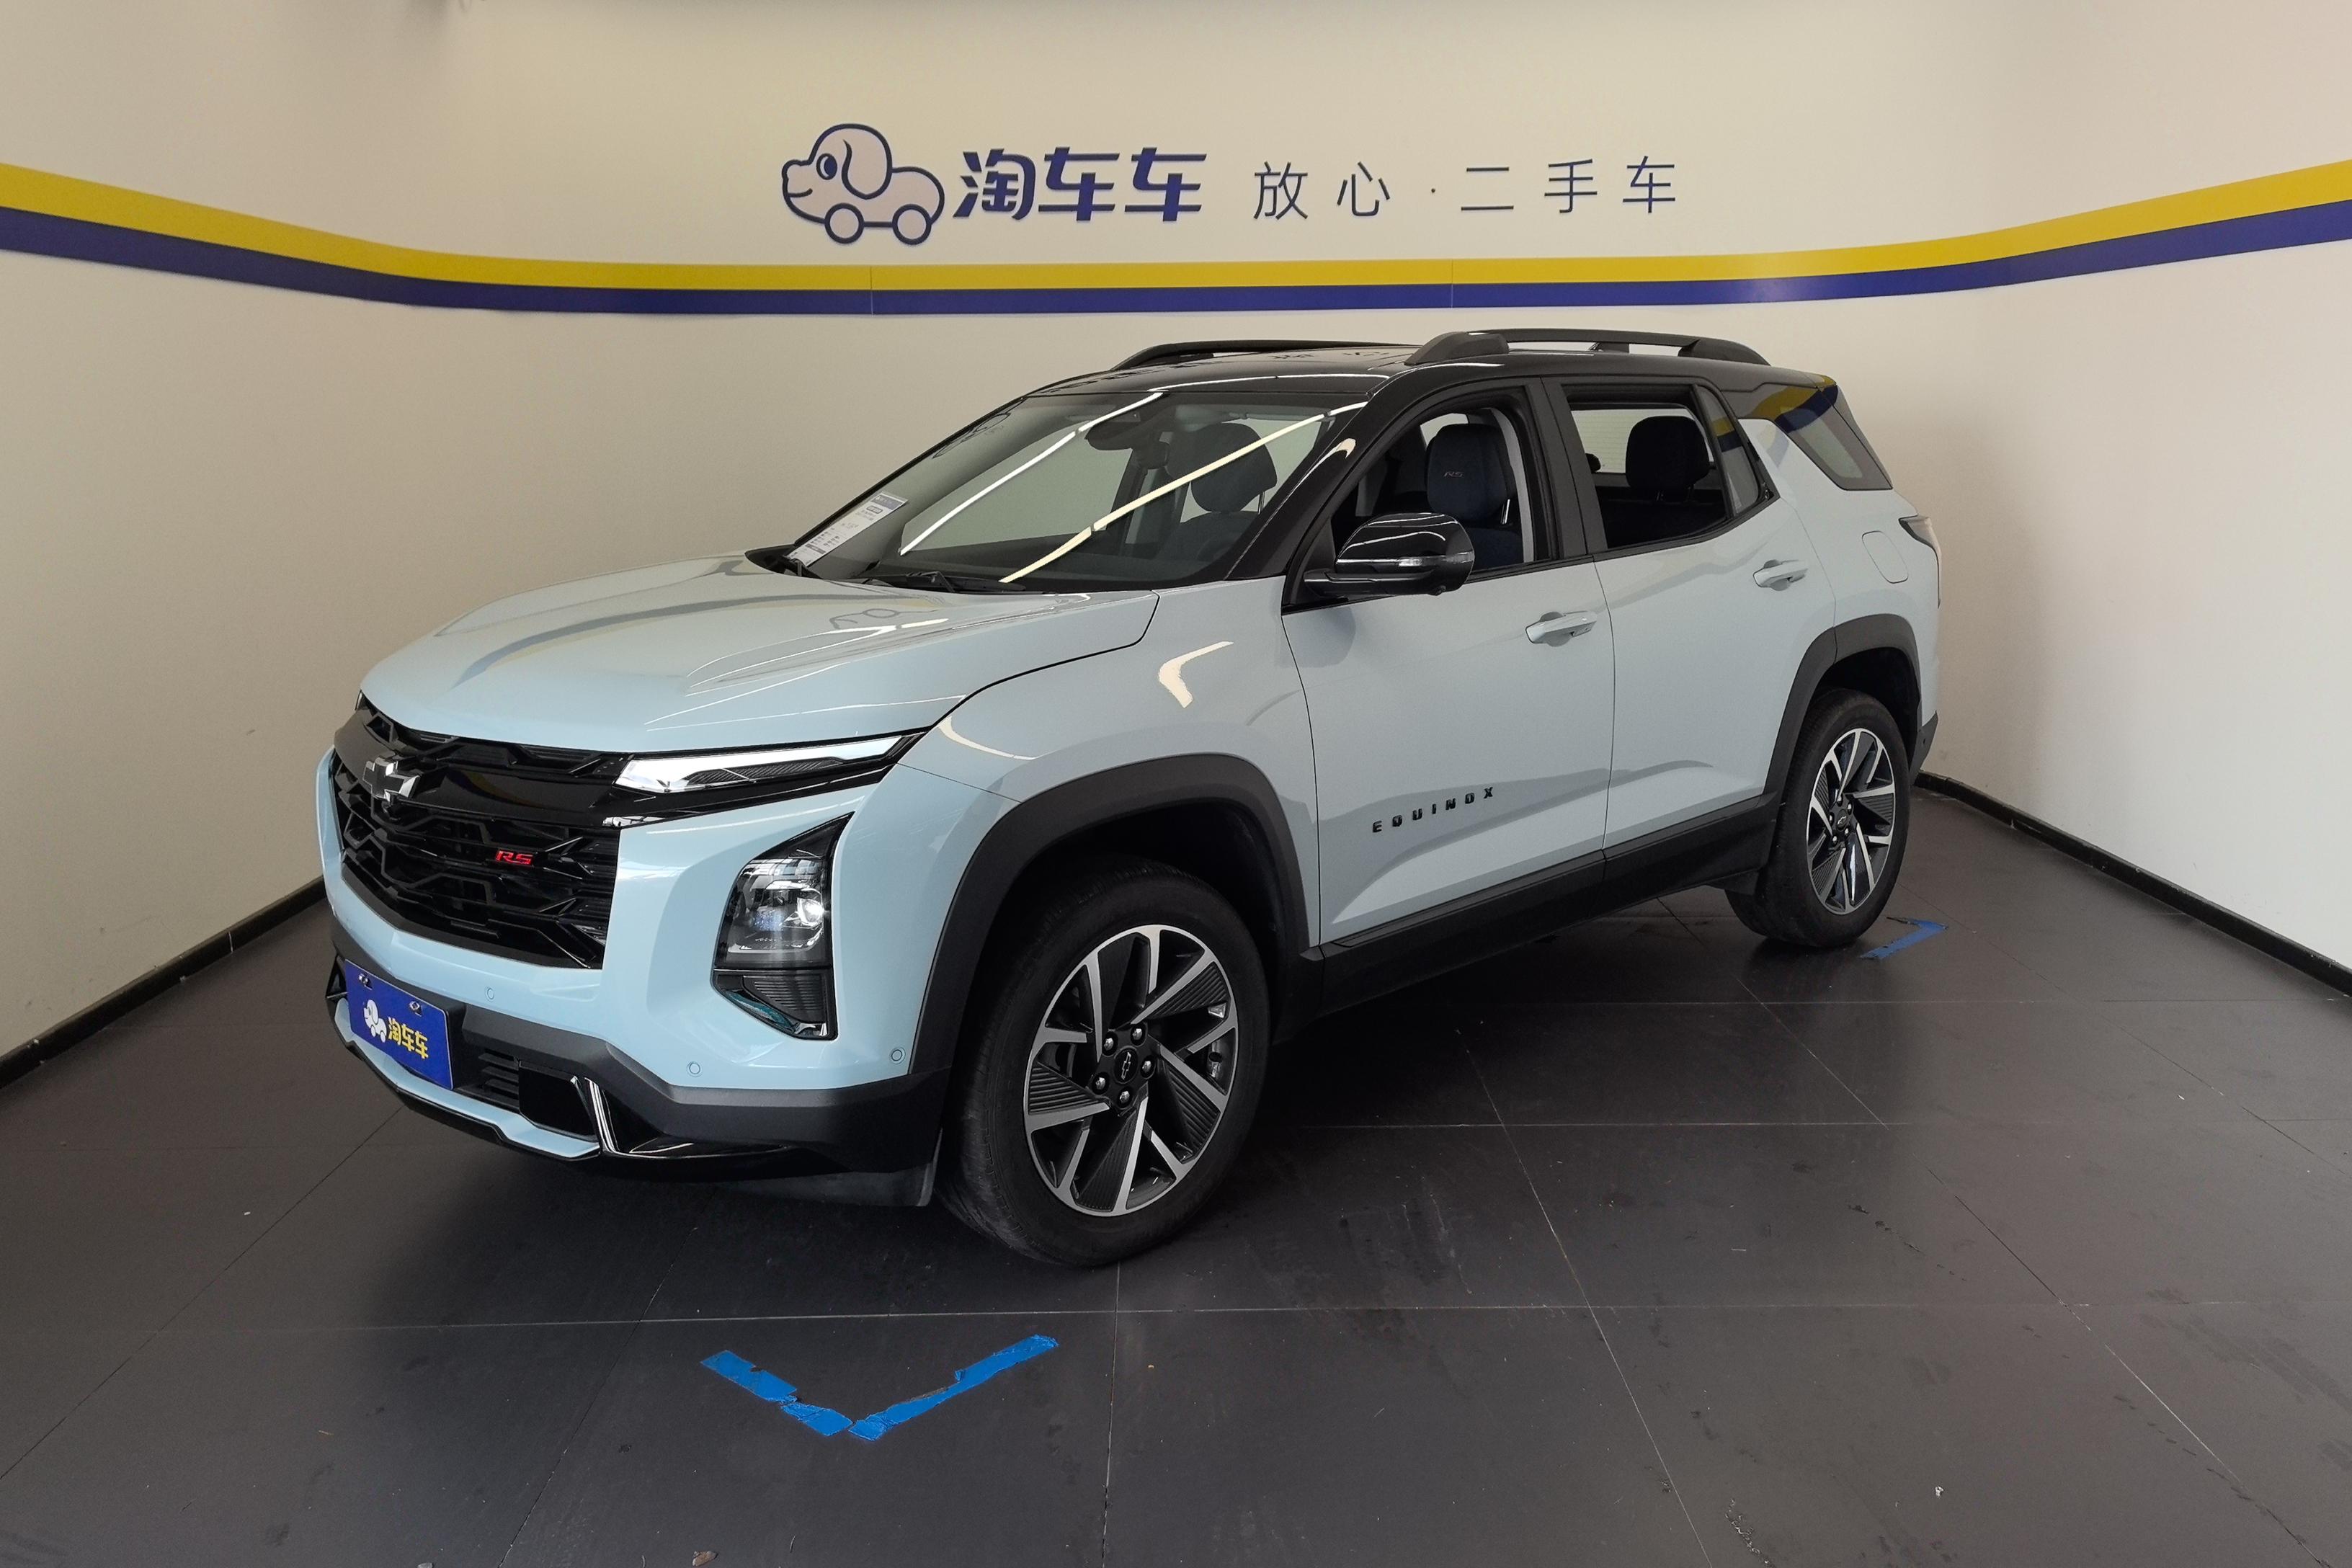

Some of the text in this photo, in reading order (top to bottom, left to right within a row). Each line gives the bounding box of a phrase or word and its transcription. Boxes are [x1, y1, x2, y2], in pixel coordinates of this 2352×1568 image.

[952, 146, 1207, 222] 淘车车
[1372, 786, 1494, 833] EQUINOX
[495, 850, 533, 865] RS
[388, 1016, 429, 1060] 淘车车
